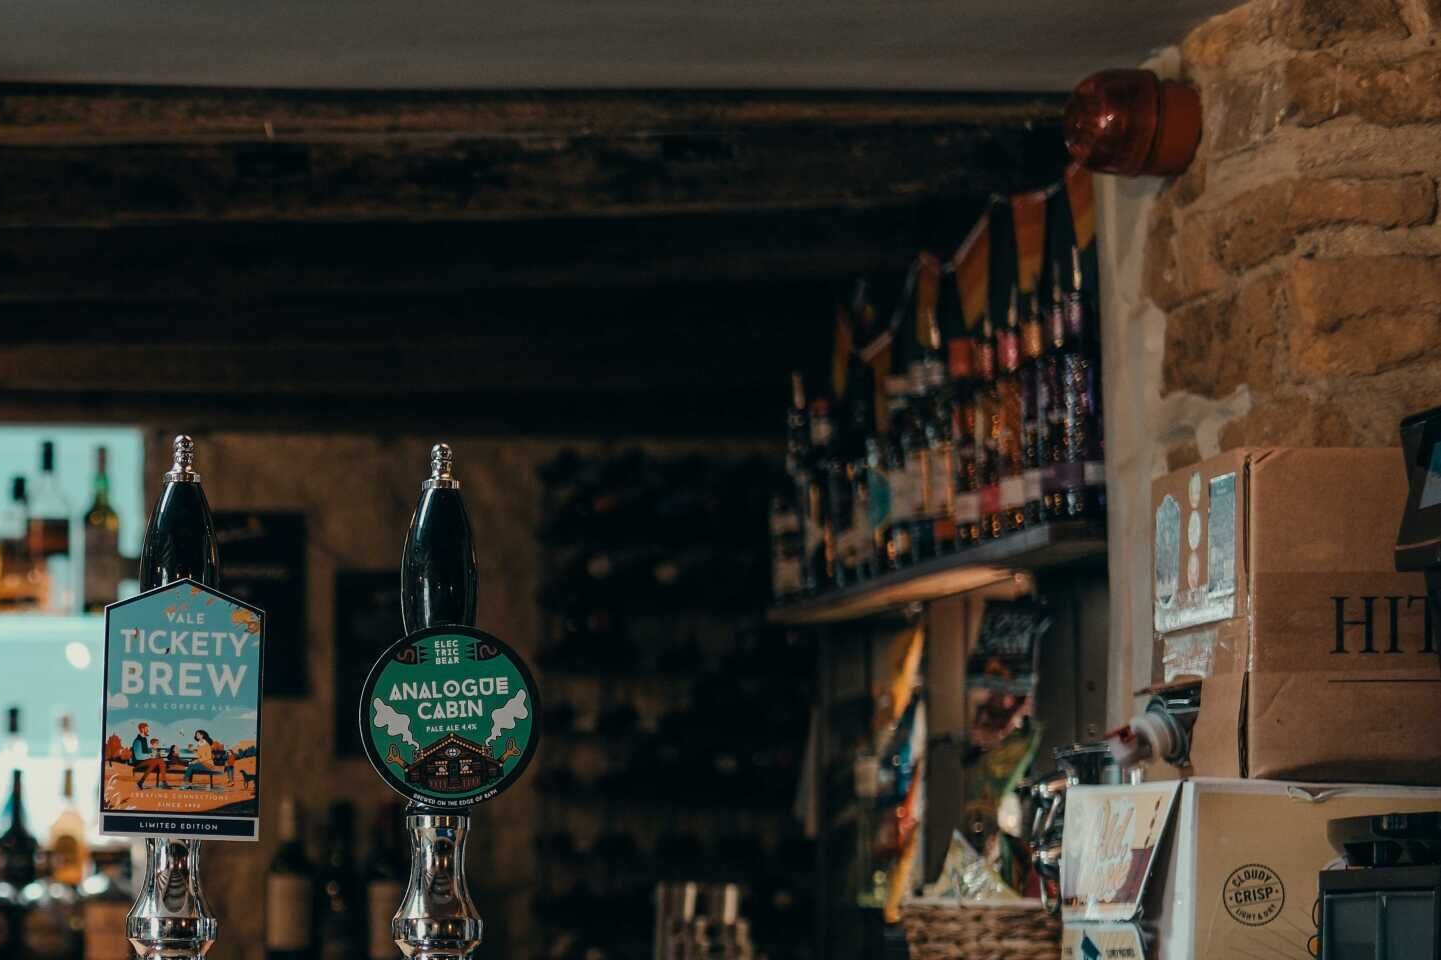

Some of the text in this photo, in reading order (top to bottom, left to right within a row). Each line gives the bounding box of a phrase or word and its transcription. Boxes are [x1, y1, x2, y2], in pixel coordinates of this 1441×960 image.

[166, 612, 205, 625] VALE
[120, 629, 249, 657] TICKETY
[434, 640, 459, 648] ELEC
[434, 648, 460, 656] TRIC
[435, 656, 461, 665] BEAR
[120, 660, 248, 698] BREW
[389, 677, 510, 701] ANALOGUE
[417, 700, 484, 720] CABIN
[425, 725, 445, 733] PALE
[180, 823, 218, 831] EDITION
[1232, 868, 1272, 887] CLOUDY
[1234, 886, 1273, 903] CRISP
